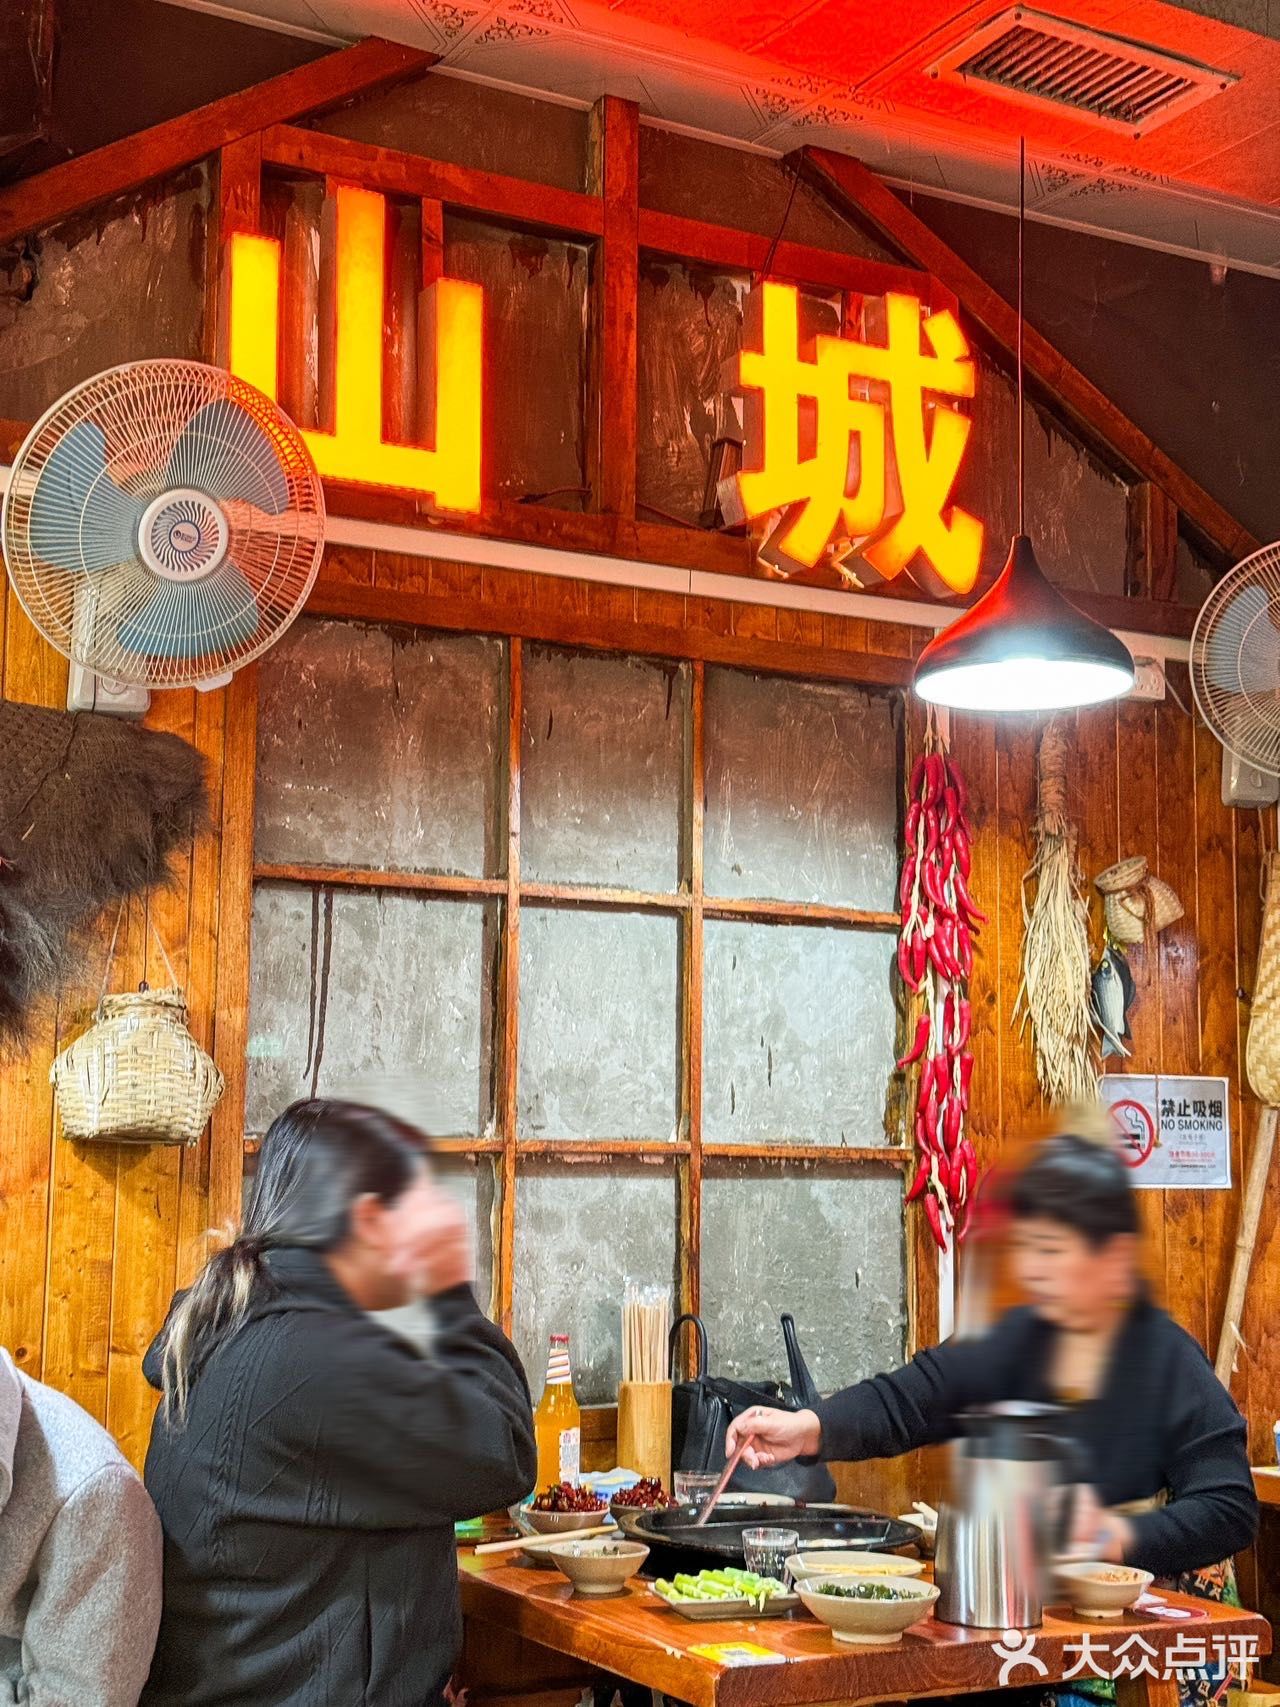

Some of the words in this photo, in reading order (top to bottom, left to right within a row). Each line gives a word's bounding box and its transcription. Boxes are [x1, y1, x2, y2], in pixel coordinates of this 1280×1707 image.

[230, 186, 984, 595] 山城
[1161, 1099, 1223, 1119] 禁止吸烟
[1161, 1119, 1175, 1130] NO
[1178, 1119, 1223, 1131] SMOKING
